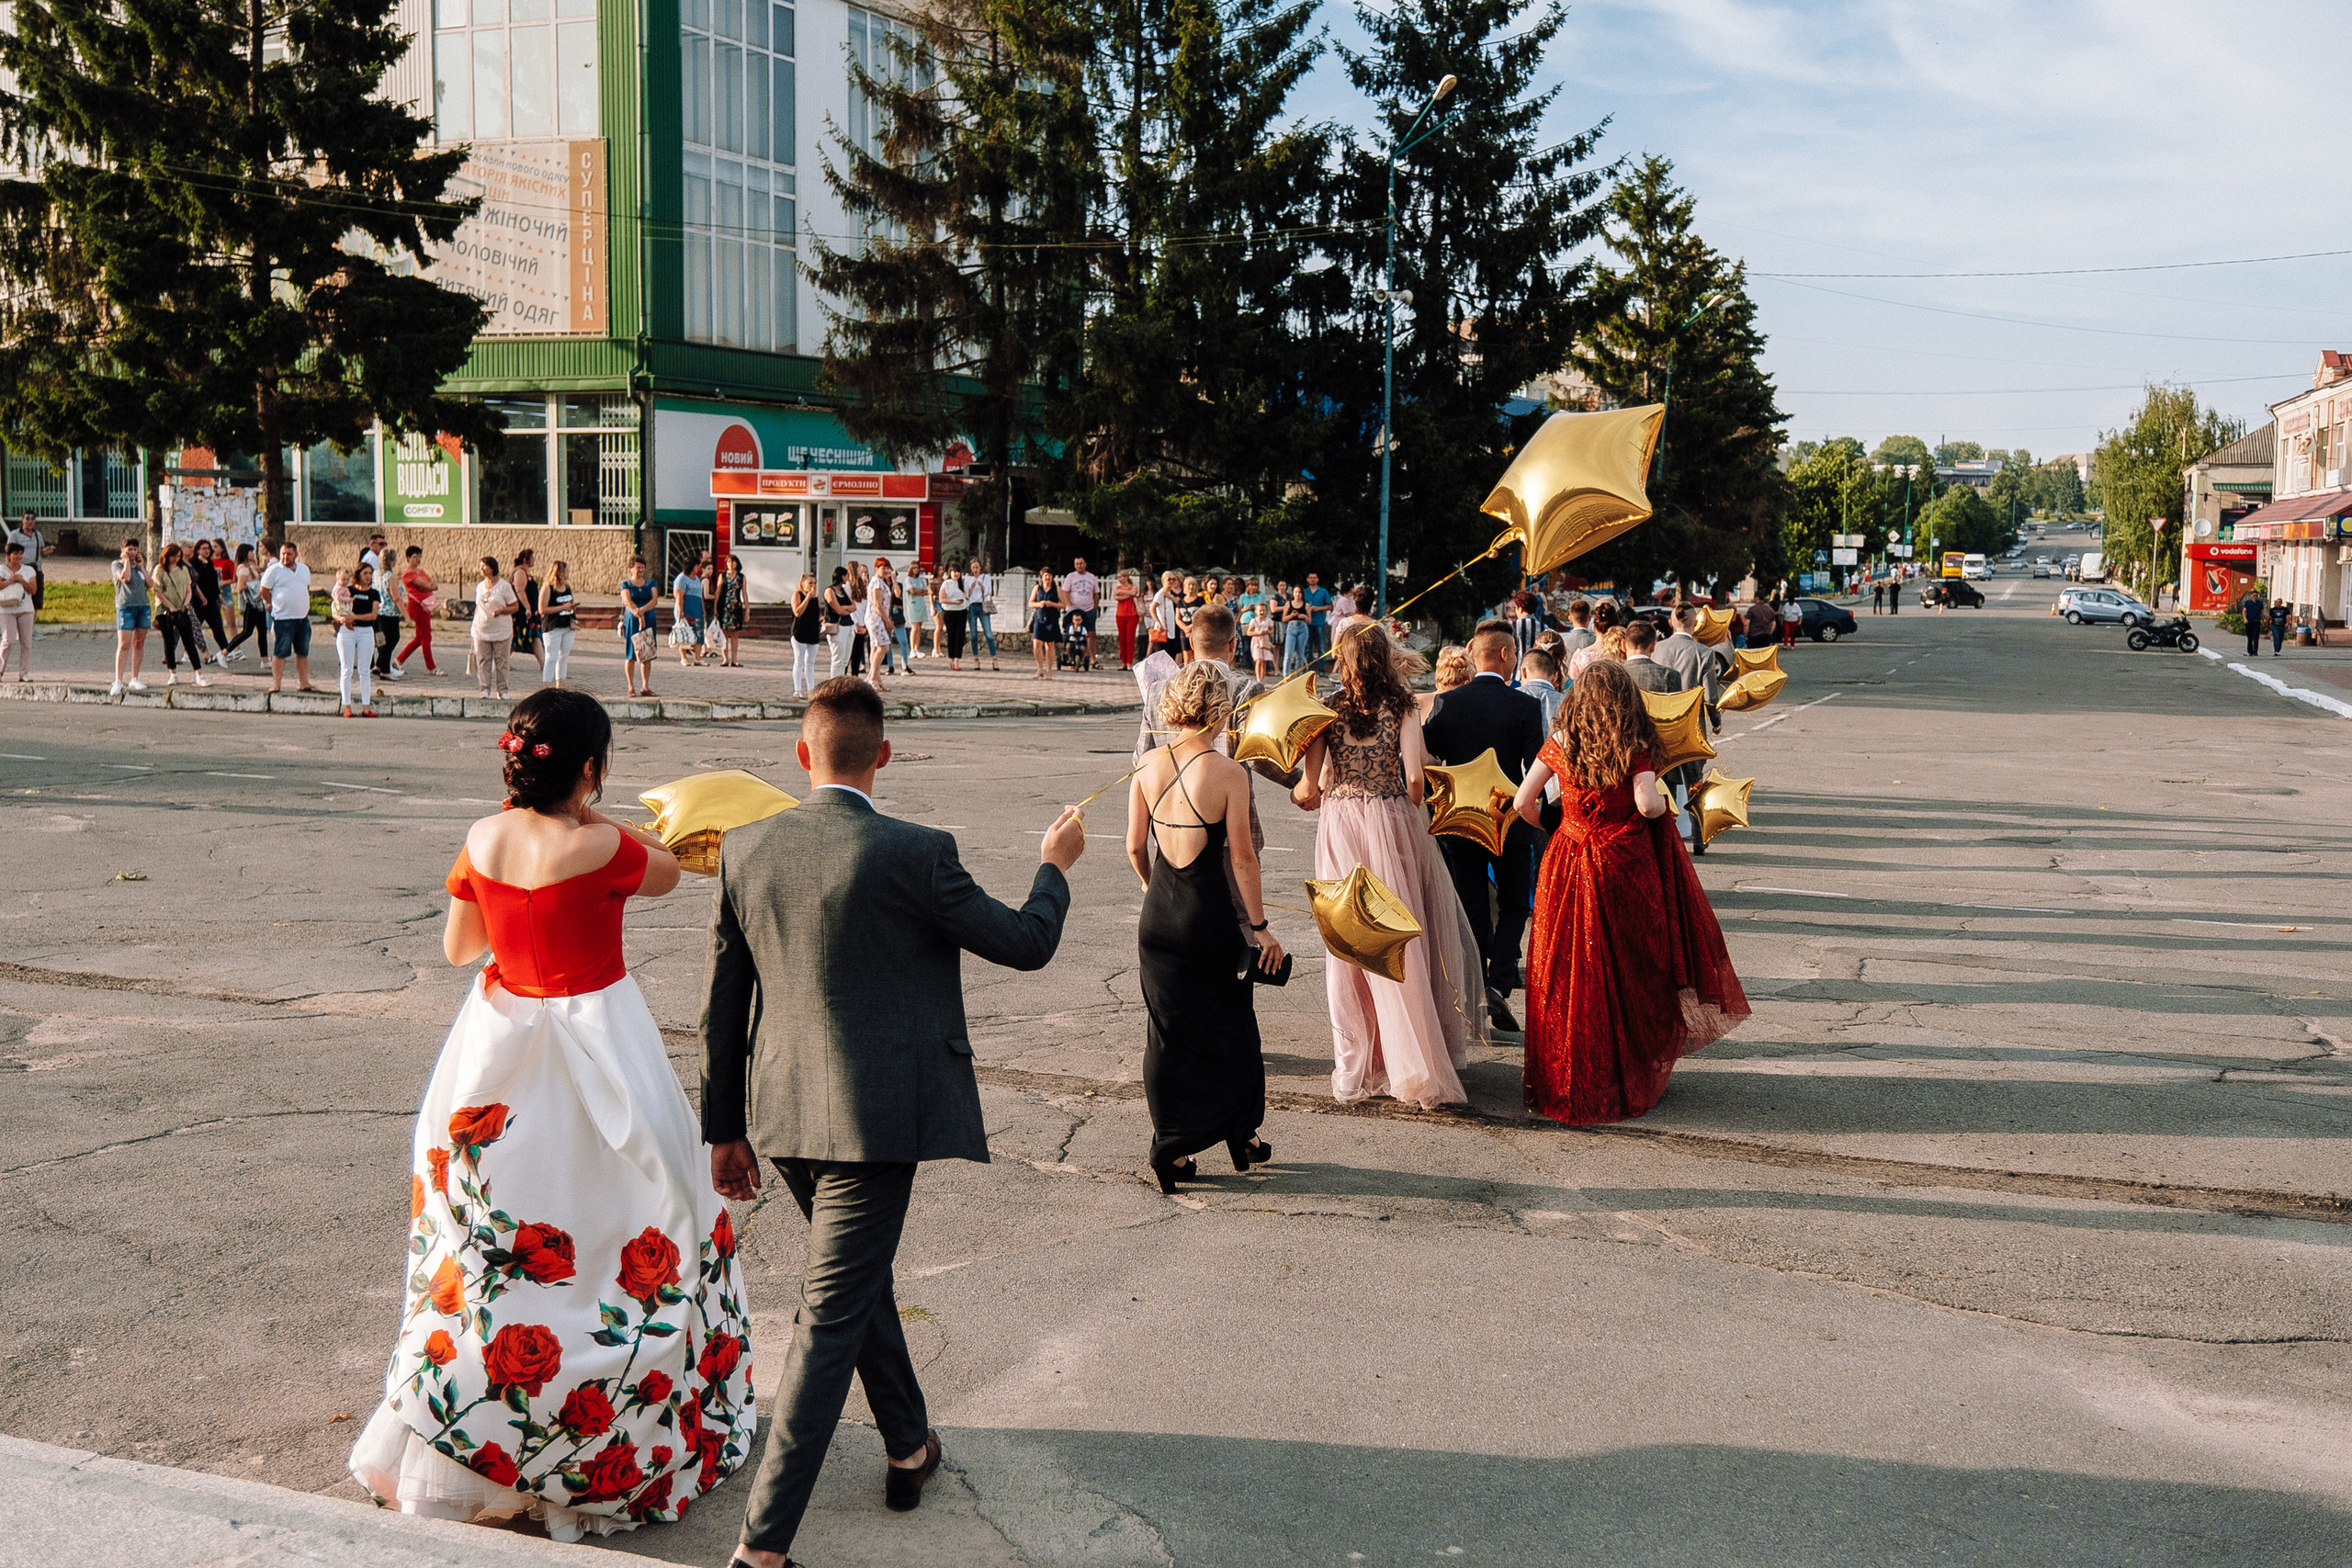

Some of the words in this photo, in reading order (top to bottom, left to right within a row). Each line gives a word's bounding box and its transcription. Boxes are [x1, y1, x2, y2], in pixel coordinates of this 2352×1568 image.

[473, 152, 504, 168] АГАЗИН
[506, 160, 540, 177] НОВОГО
[510, 175, 567, 200] ЯКІСНИХ
[484, 207, 568, 243] ЖІНОЧИЙ
[581, 152, 595, 321] СУПЕРЦІНА
[513, 299, 560, 325] ОДЯГ
[720, 450, 753, 465] НОВИЙ
[810, 447, 874, 467] ЧЕСНІШИЙ
[397, 463, 449, 498] ВІДДАСИ
[762, 479, 807, 490] ПРОДУКТИ
[405, 506, 435, 514] COMFY
[2220, 547, 2254, 556] vodafone
